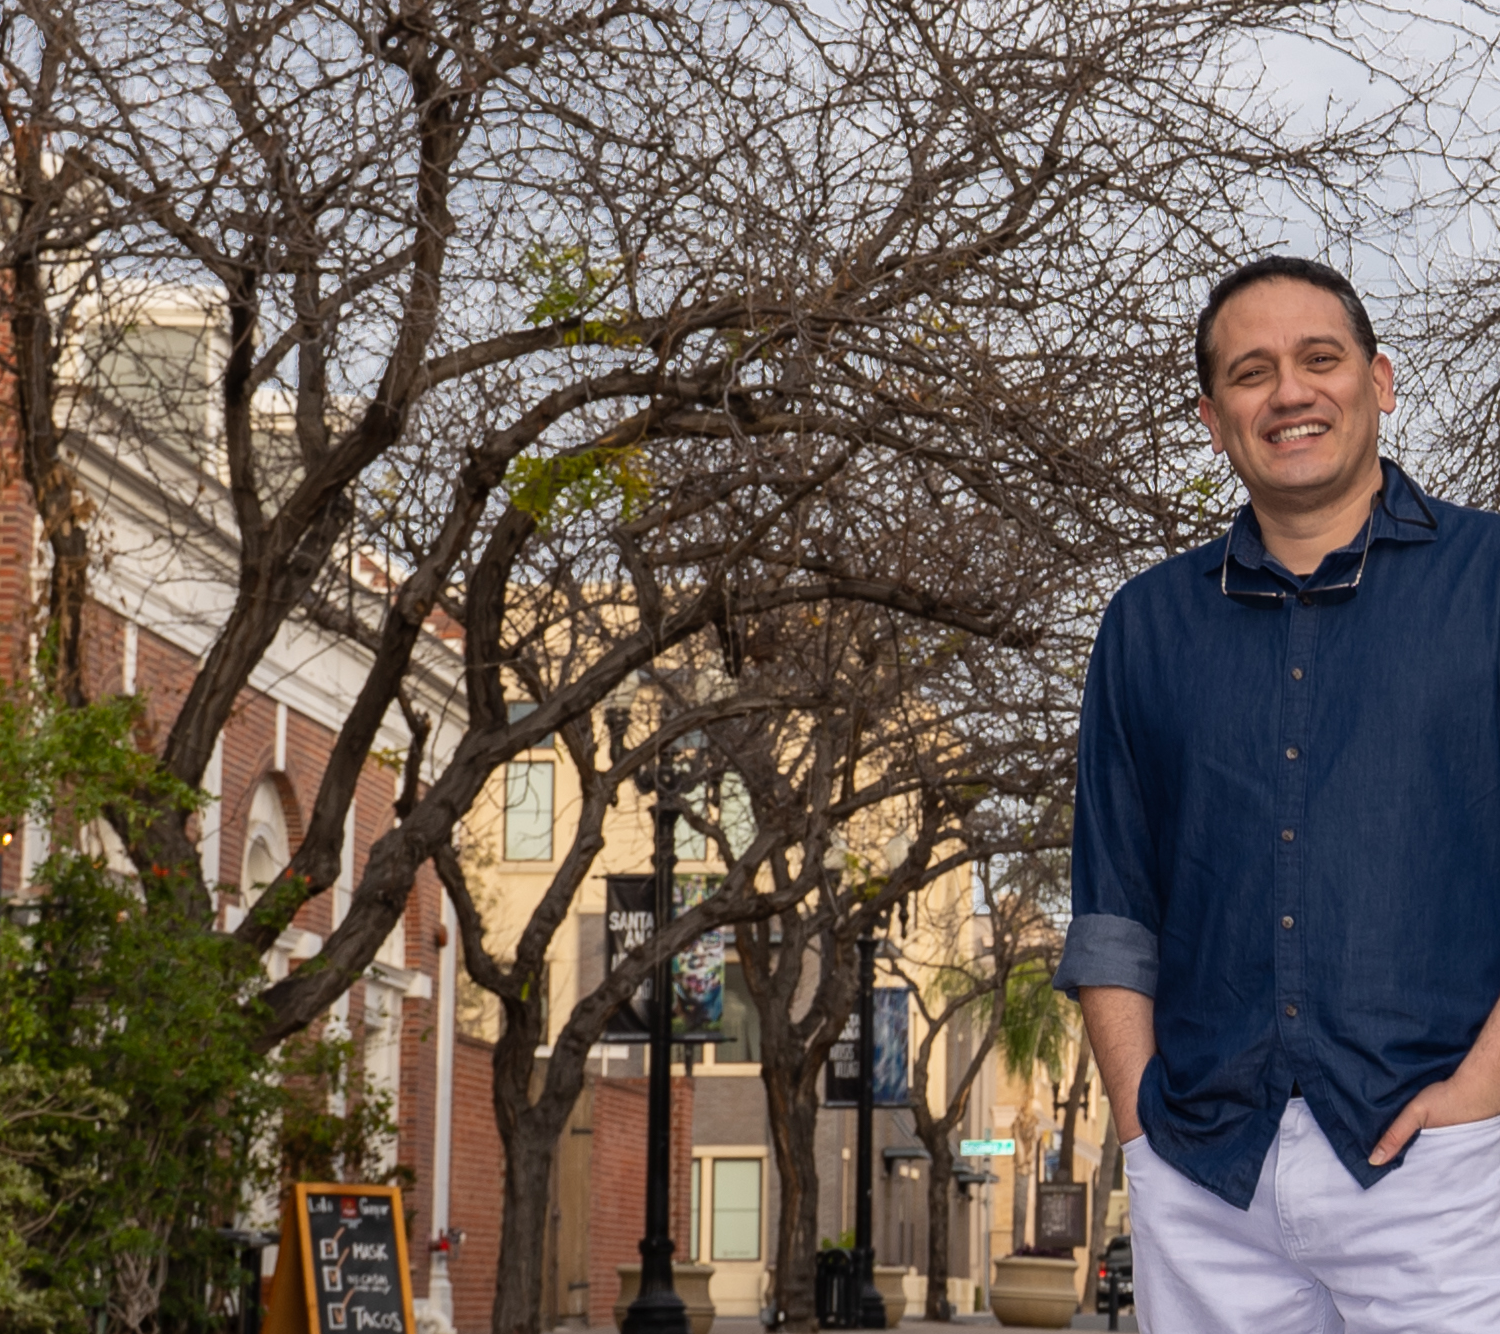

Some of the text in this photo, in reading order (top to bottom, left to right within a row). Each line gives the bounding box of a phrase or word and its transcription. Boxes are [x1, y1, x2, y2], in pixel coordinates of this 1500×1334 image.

[609, 911, 654, 931] SANTA
[352, 1241, 389, 1261] MASK
[351, 1305, 402, 1333] TACOS
